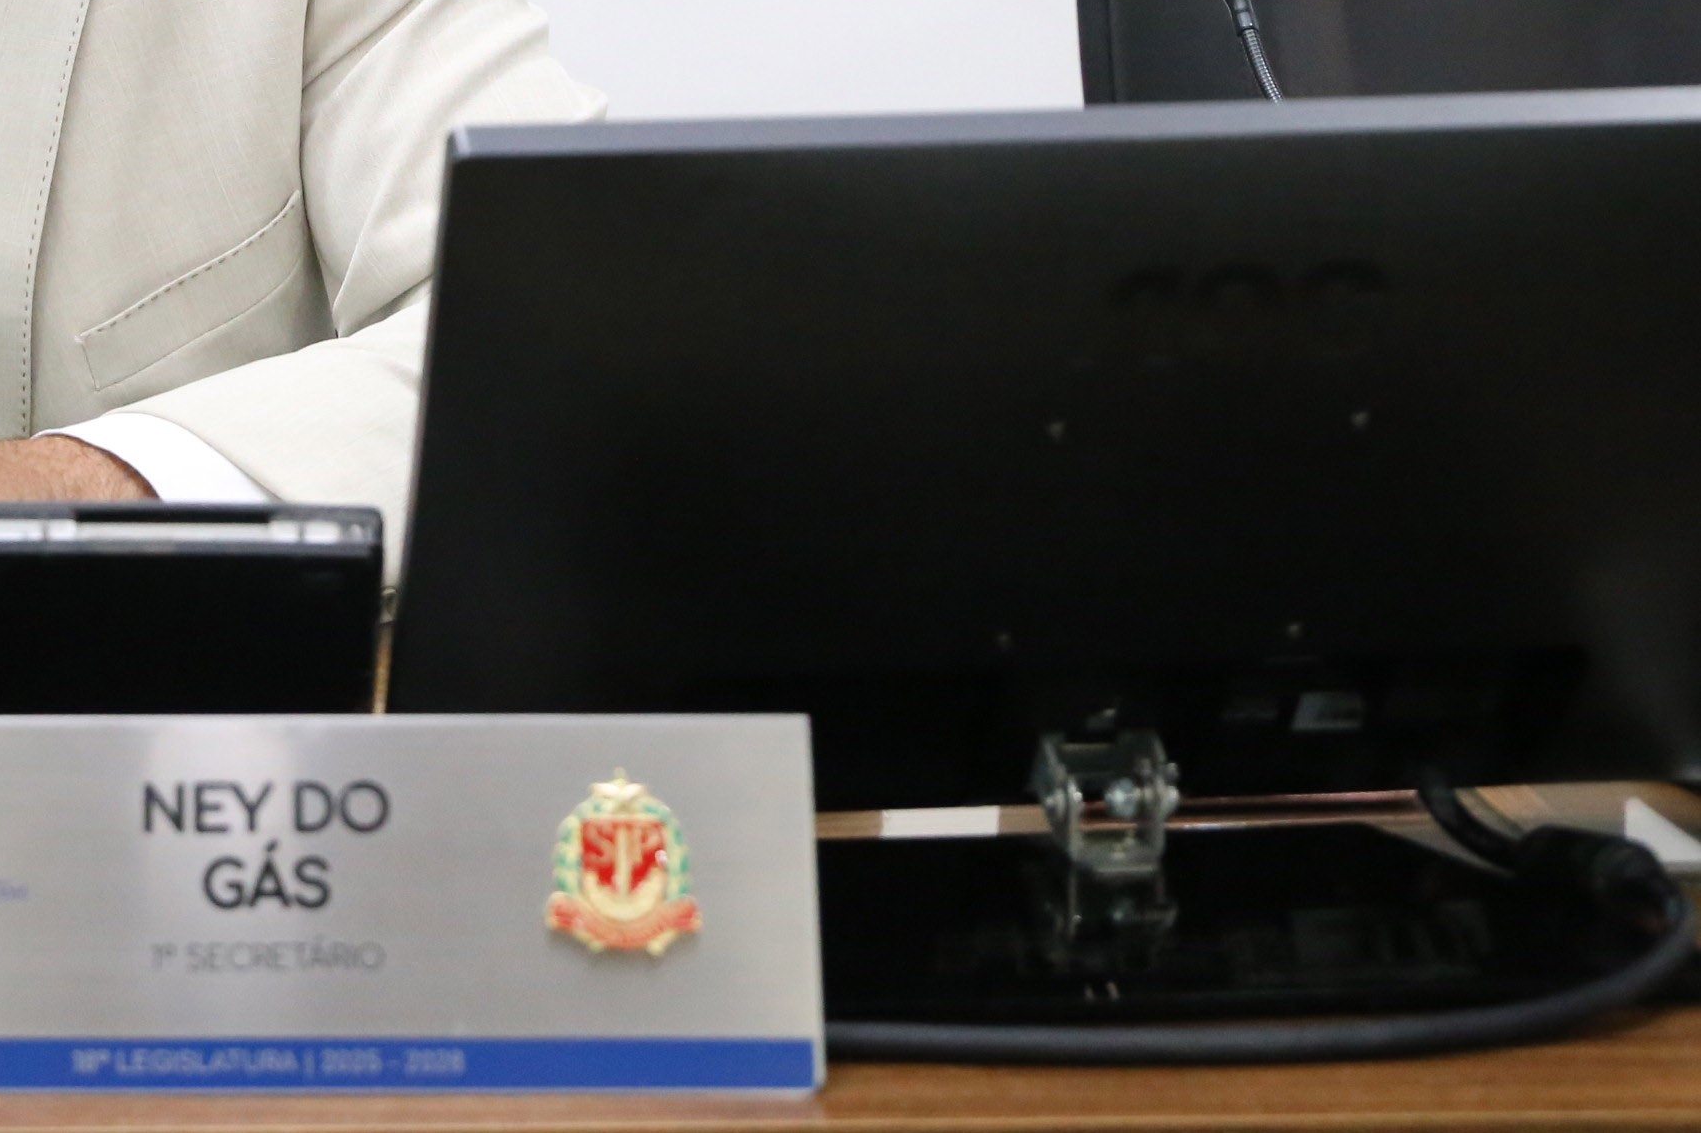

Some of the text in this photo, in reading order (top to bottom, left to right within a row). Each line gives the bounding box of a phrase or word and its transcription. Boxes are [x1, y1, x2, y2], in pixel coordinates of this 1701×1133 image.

[142, 779, 389, 833] NEY DO
[203, 840, 330, 909] GÁS
[186, 934, 387, 970] SECRETÁRIO
[115, 1047, 298, 1074] LEGISLATURA
